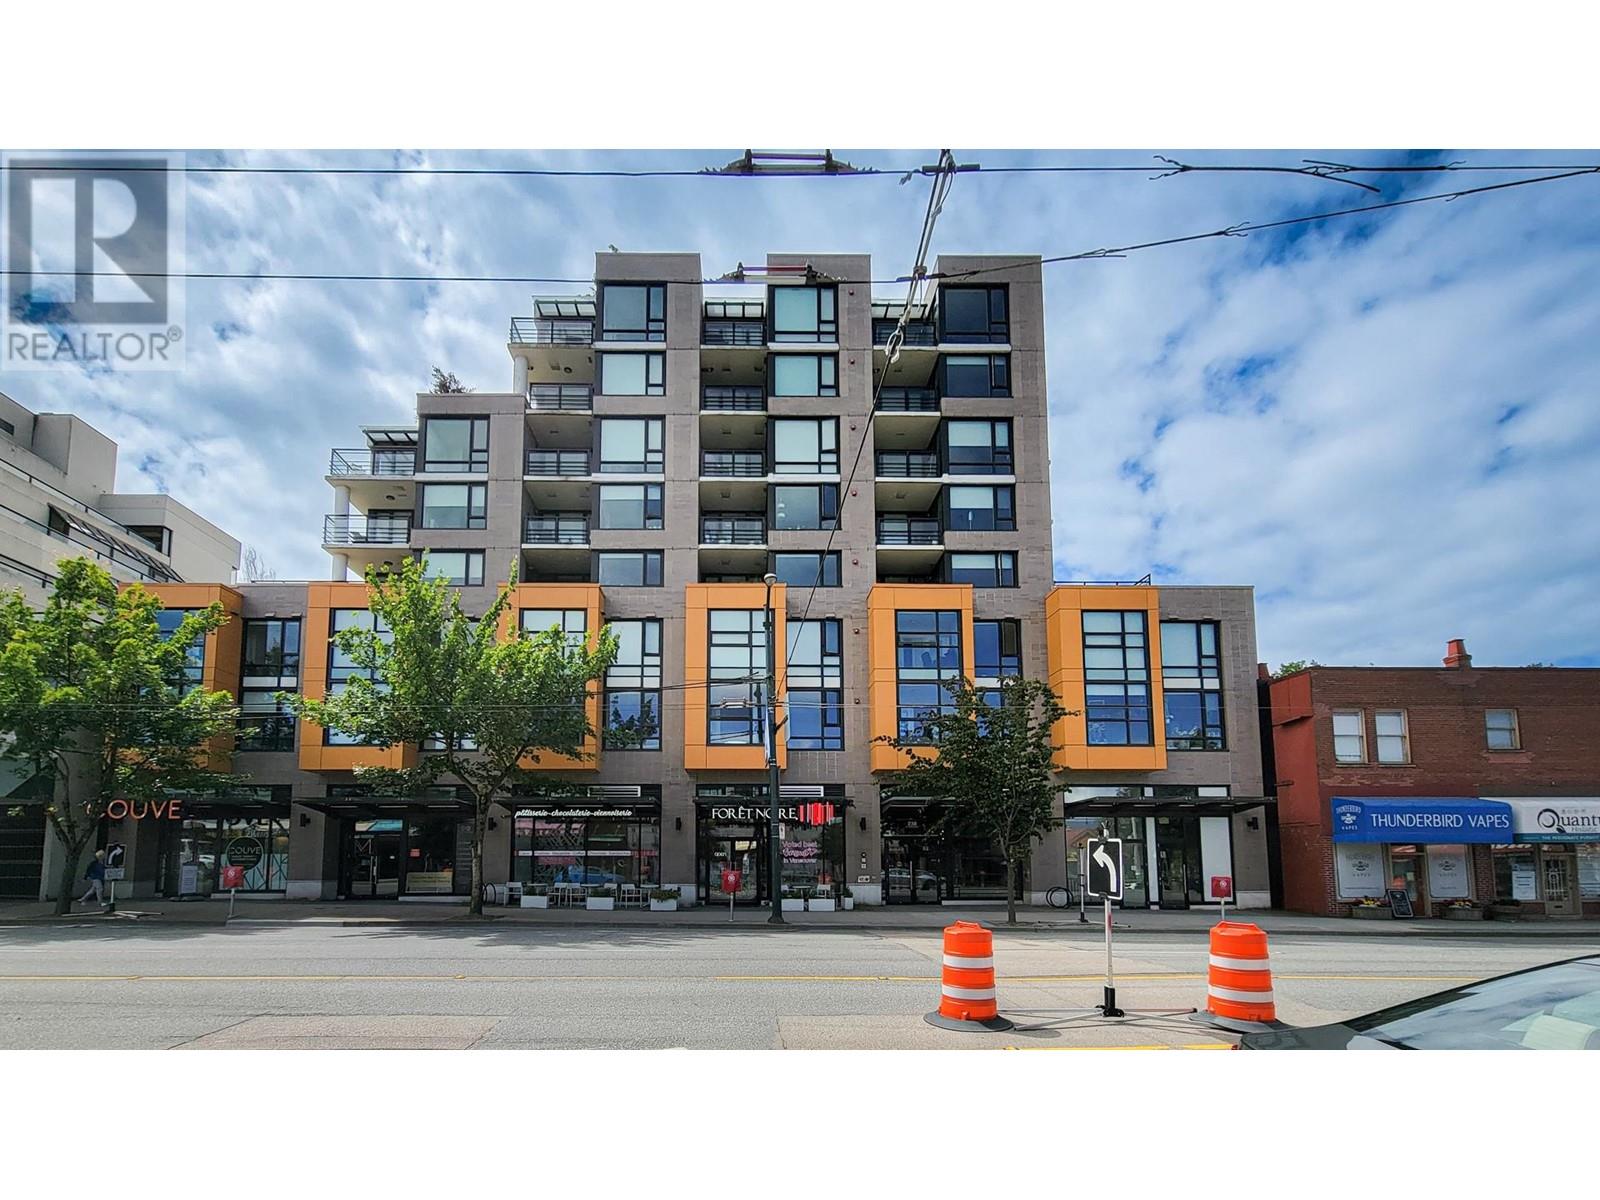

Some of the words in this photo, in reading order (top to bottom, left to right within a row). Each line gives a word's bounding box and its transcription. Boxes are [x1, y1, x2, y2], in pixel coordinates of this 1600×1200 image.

[711, 805, 754, 820] FORÊT
[755, 807, 797, 820] NORE
[1370, 813, 1464, 828] THUNDERBIRD
[1467, 814, 1510, 828] VAPES
